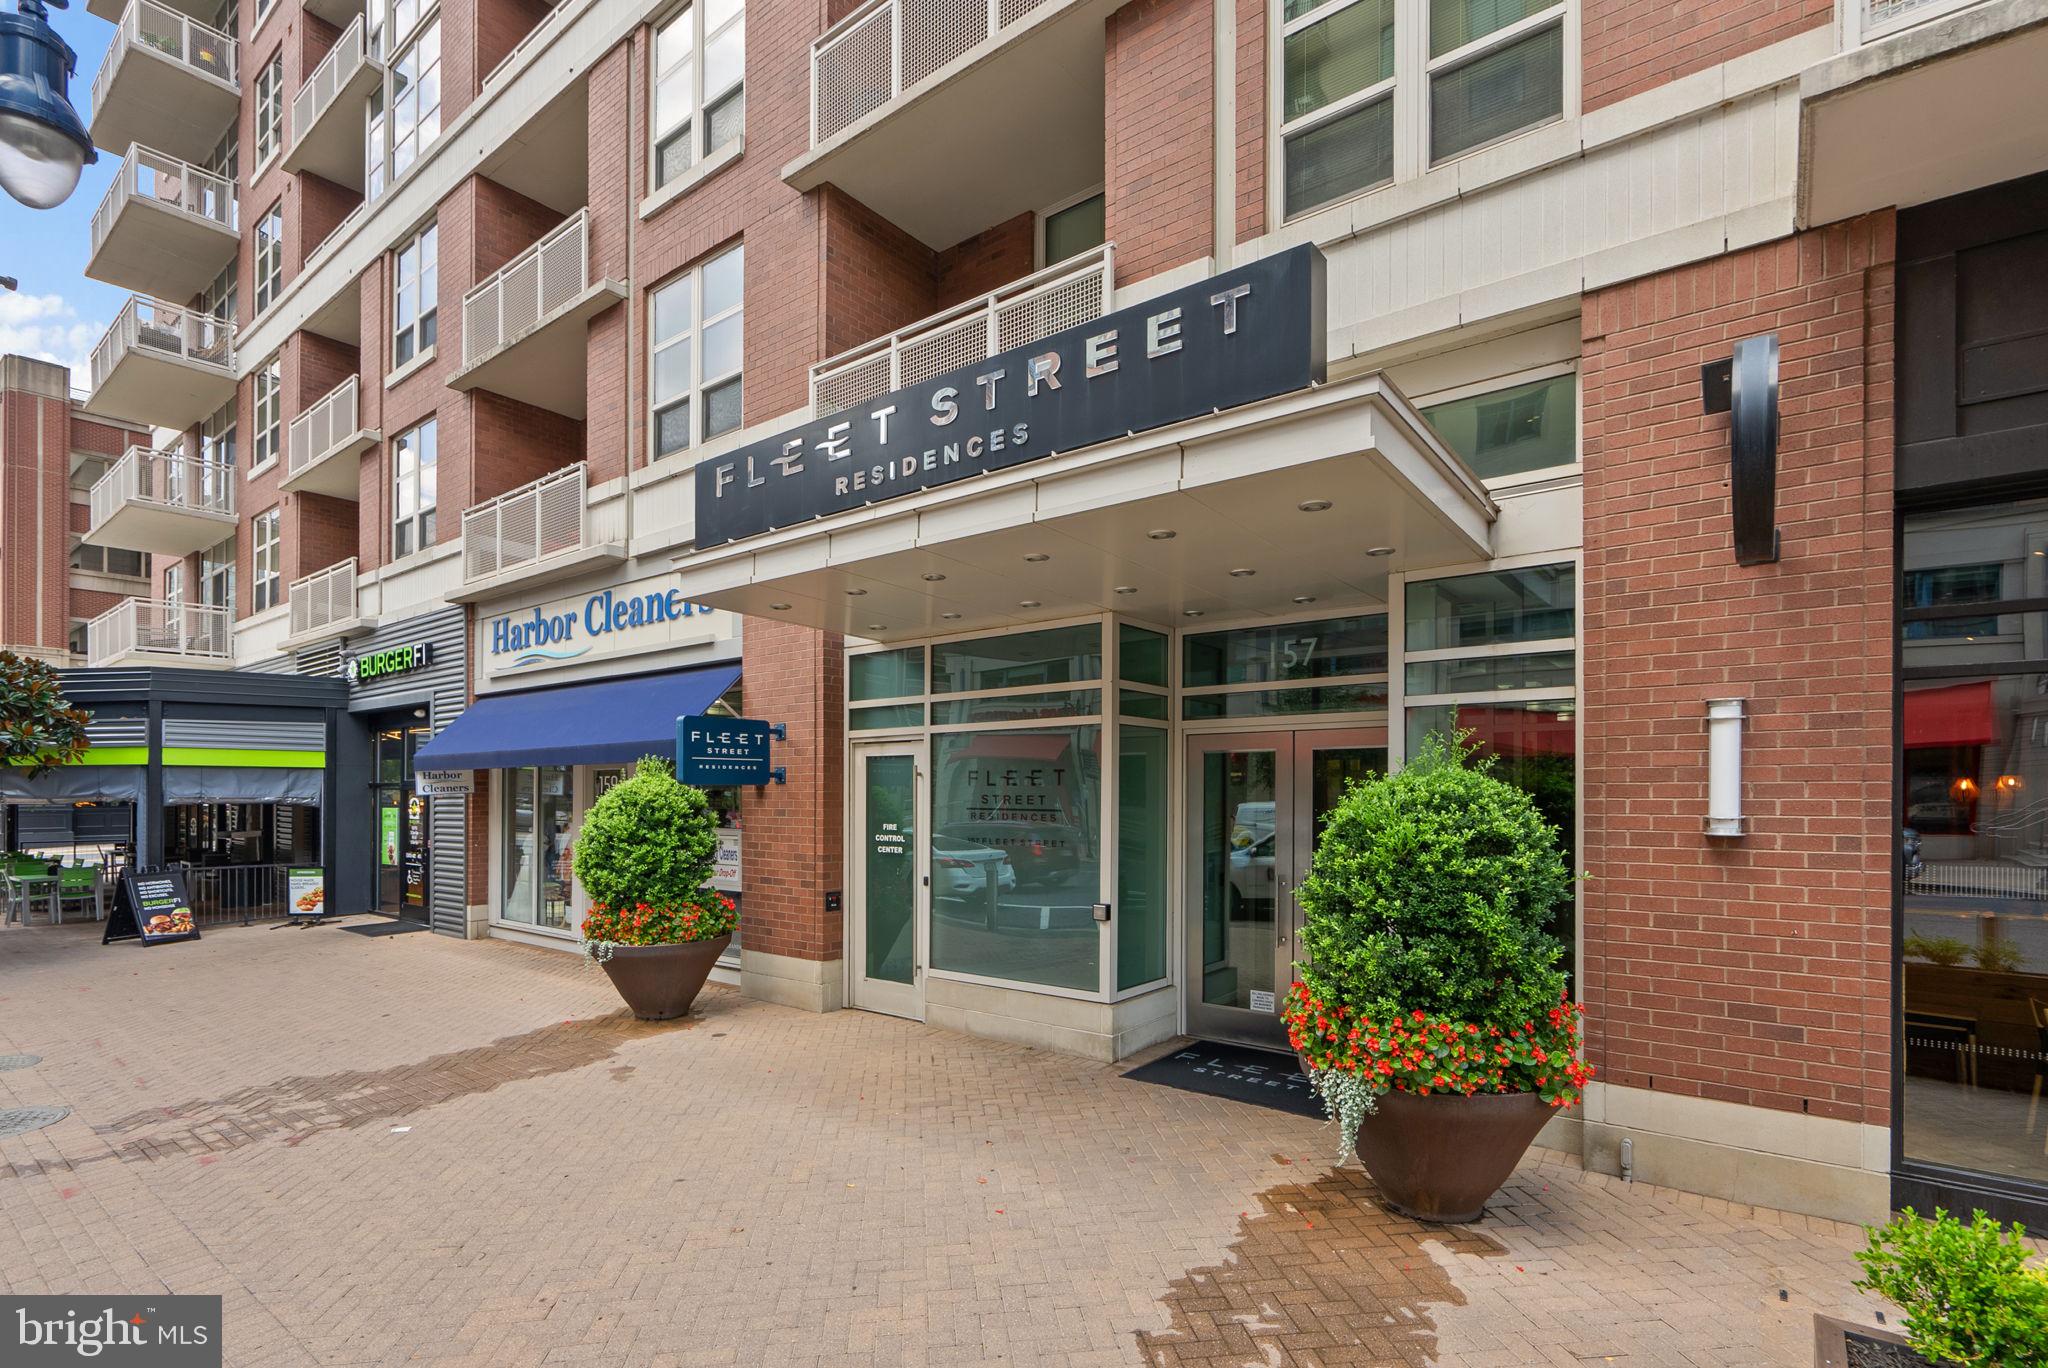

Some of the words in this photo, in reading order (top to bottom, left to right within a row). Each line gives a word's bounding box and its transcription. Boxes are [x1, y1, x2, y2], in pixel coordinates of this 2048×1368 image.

[714, 405, 899, 498] FLEET
[929, 283, 1252, 427] STREET
[834, 422, 1030, 497] RESIDENCES
[491, 606, 577, 655] Harbor
[584, 588, 714, 637] Cleane
[360, 643, 426, 678] BURGERFI
[1270, 637, 1318, 669] 157
[691, 730, 764, 745] FLEET
[706, 747, 750, 755] STREET
[423, 771, 463, 780] Harbor
[967, 768, 1066, 787] FLEET
[422, 784, 470, 793] Cleaners
[981, 794, 1047, 805] STREET
[970, 811, 1058, 823] RESIDENCES
[882, 823, 898, 831] FIRE
[875, 834, 906, 843] CONTROL
[877, 845, 903, 854] CENTER
[1174, 1052, 1308, 1083] FLEE
[1192, 1067, 1300, 1090] STREET
